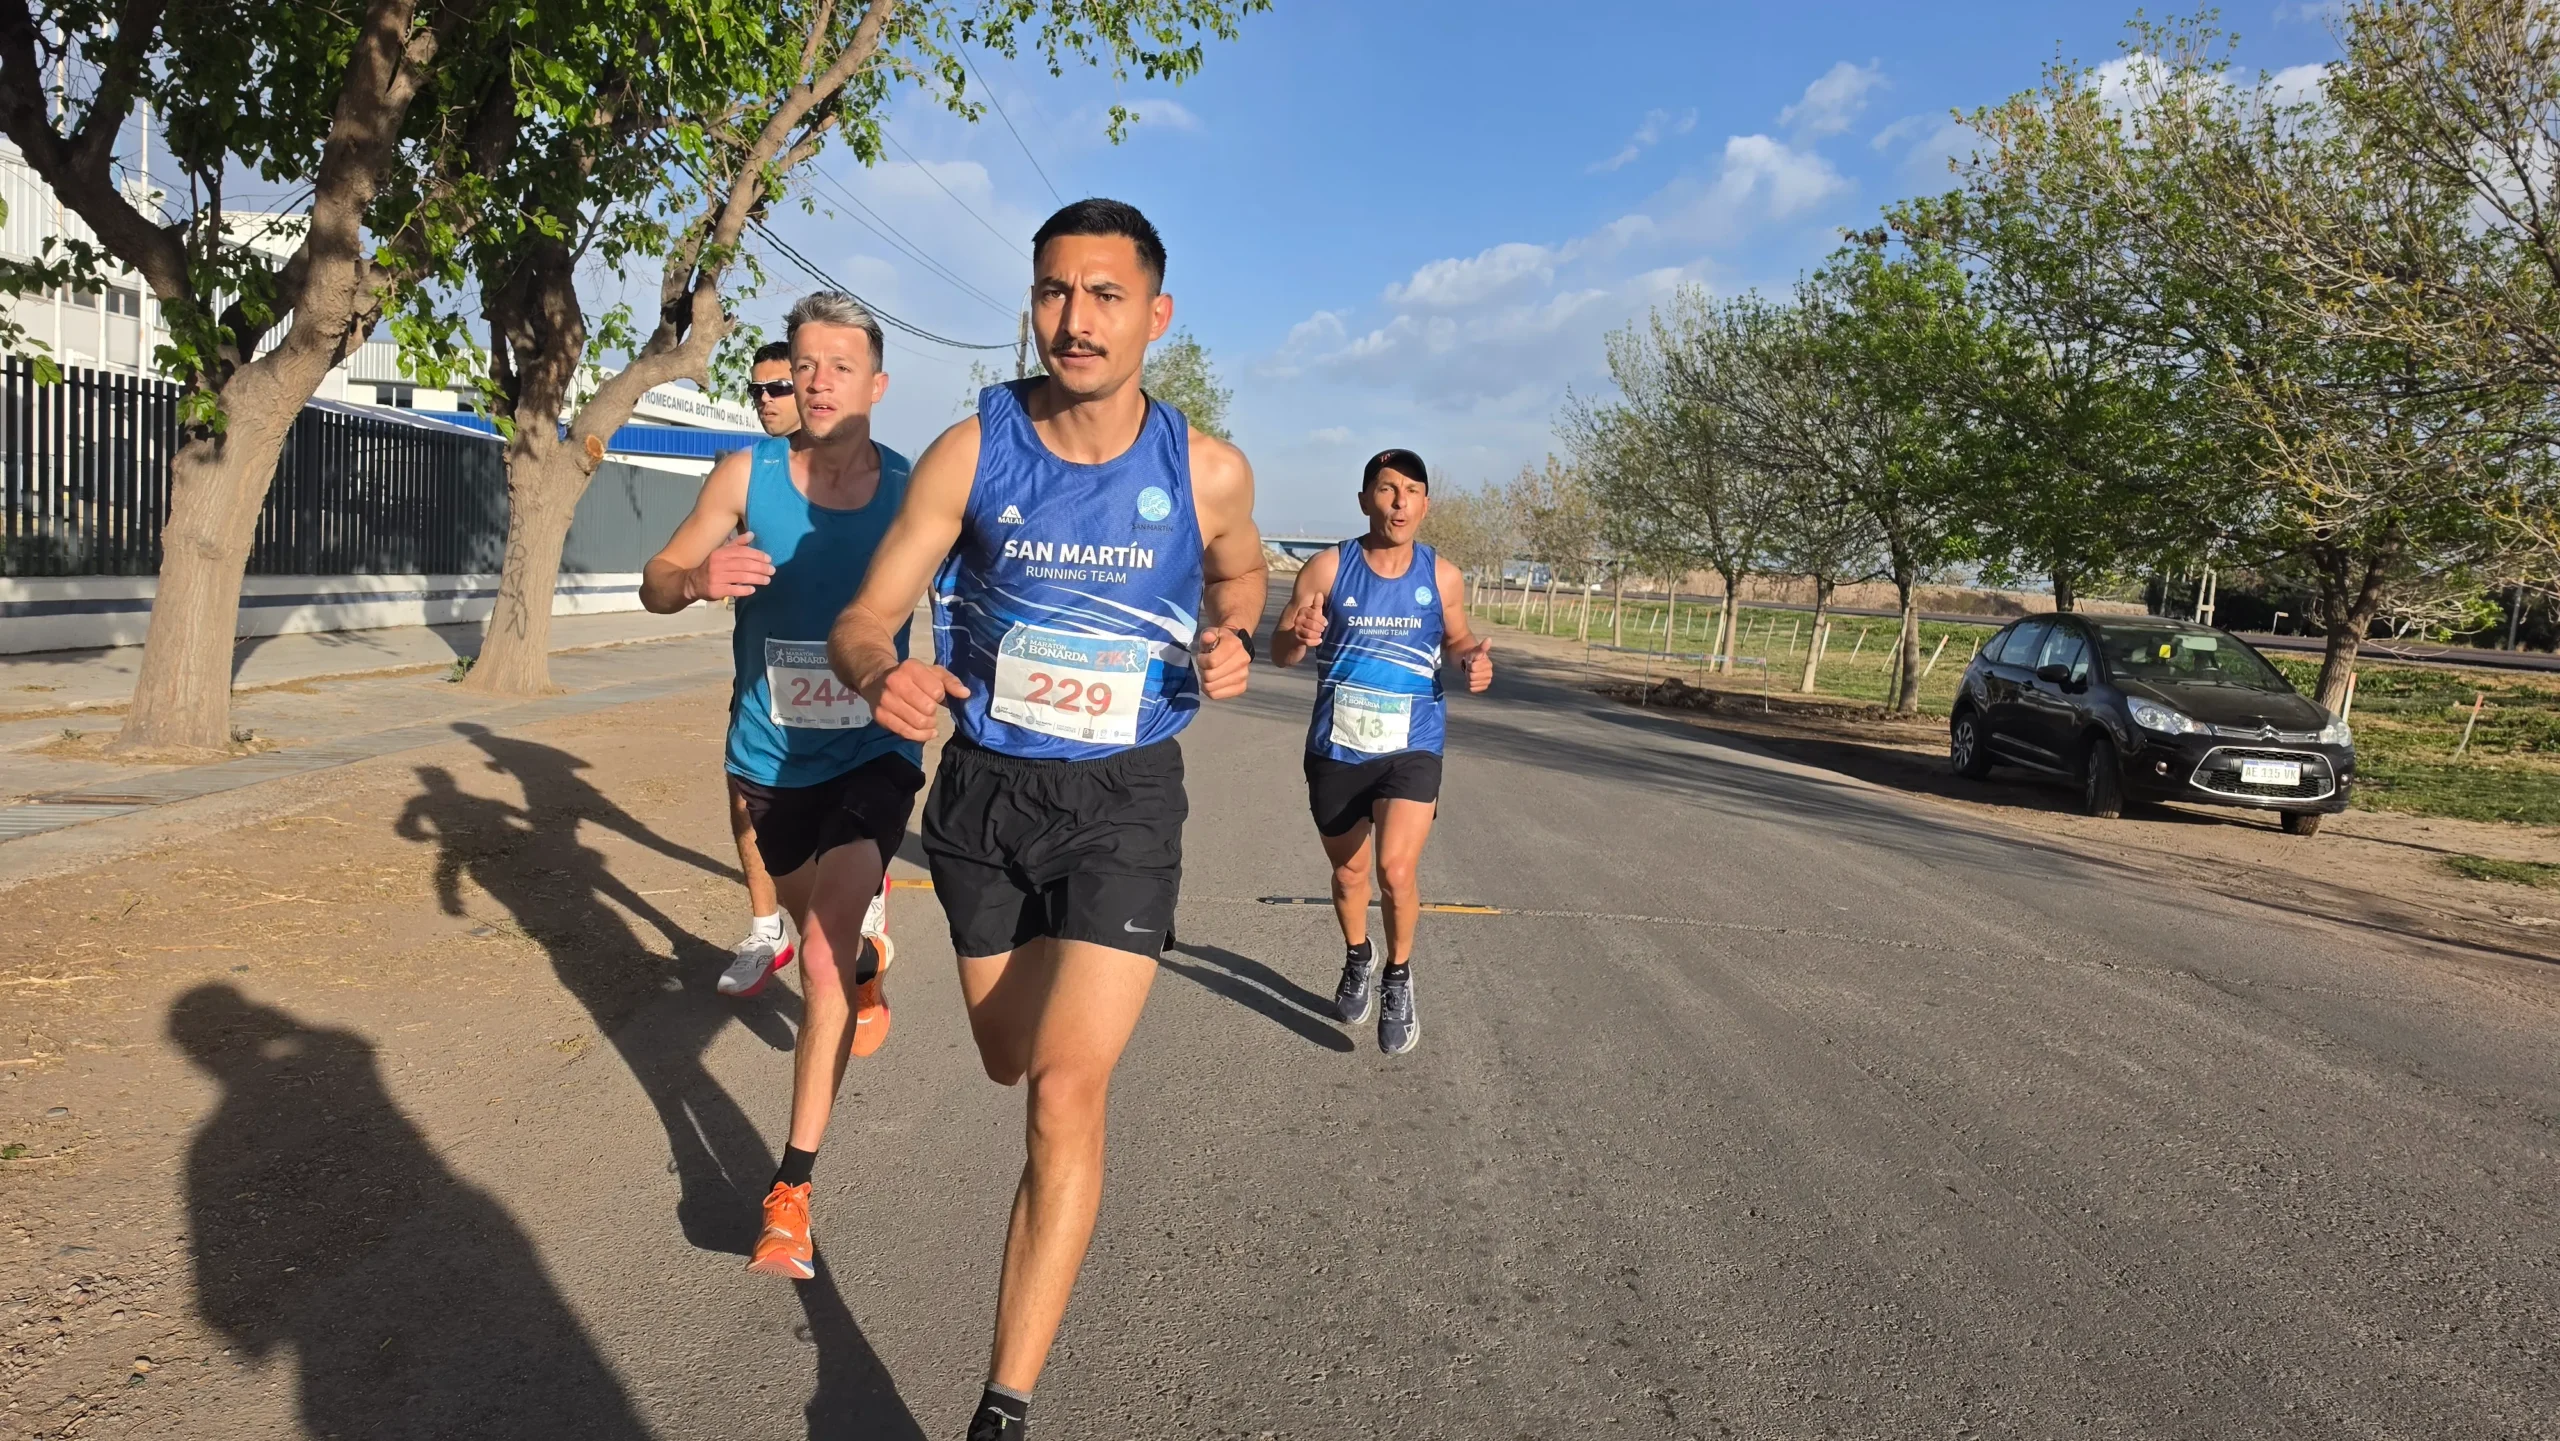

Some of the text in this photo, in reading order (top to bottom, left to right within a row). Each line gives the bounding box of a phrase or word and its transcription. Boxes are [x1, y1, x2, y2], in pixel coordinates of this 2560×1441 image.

[695, 403, 726, 421] BOTTINO
[998, 515, 1025, 525] MALAU
[1004, 539, 1154, 569] SAN MARTÍN
[1026, 565, 1127, 584] RUNNING TEAM
[1347, 615, 1422, 628] SAN MARTÍN
[1358, 628, 1389, 636] RUNNING
[1029, 639, 1067, 651] MARATÓN
[1029, 645, 1089, 663] BONARDA
[790, 677, 858, 707] 244
[1024, 672, 1113, 717] 229
[1356, 715, 1384, 739] 13
[2245, 767, 2259, 778] AE
